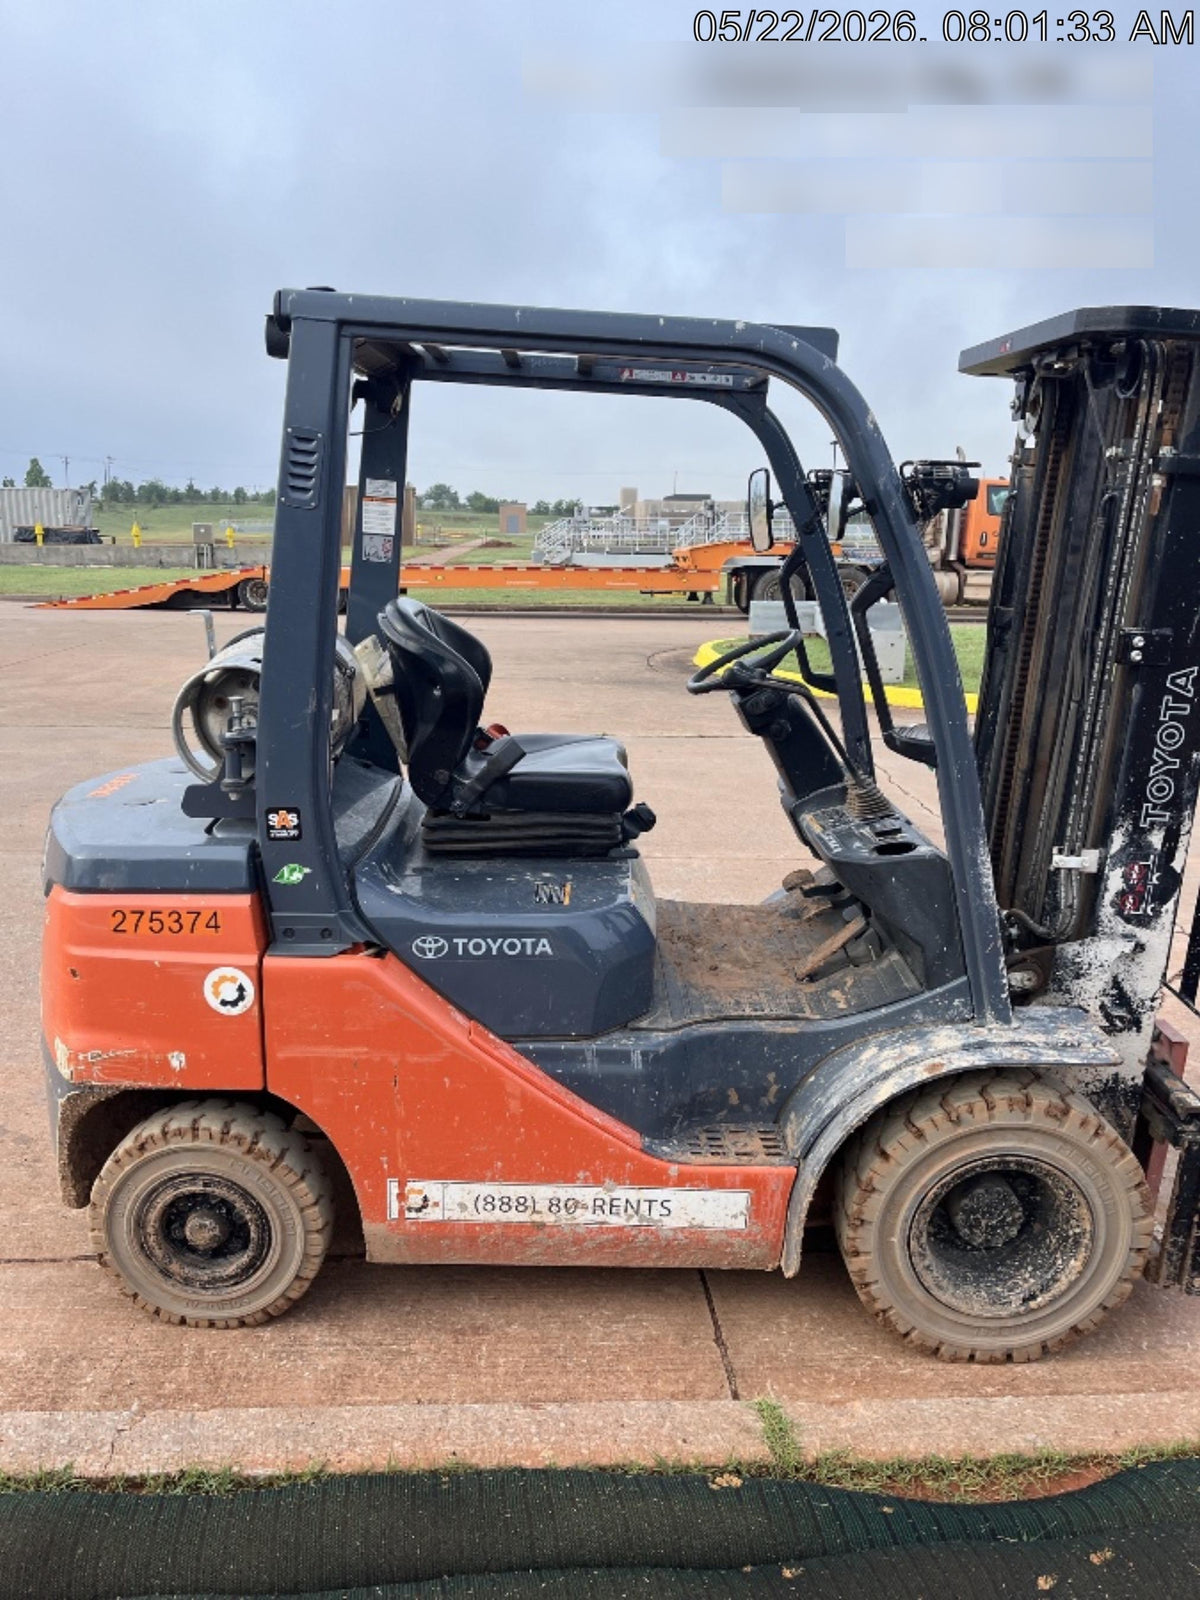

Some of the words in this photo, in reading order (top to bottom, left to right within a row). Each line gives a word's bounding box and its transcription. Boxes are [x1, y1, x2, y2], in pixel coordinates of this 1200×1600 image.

[1140, 666, 1199, 828] TOYOTA
[267, 809, 299, 829] SAS
[111, 909, 221, 934] 275374
[453, 938, 553, 956] TOYOTA
[474, 1194, 536, 1215] (888)
